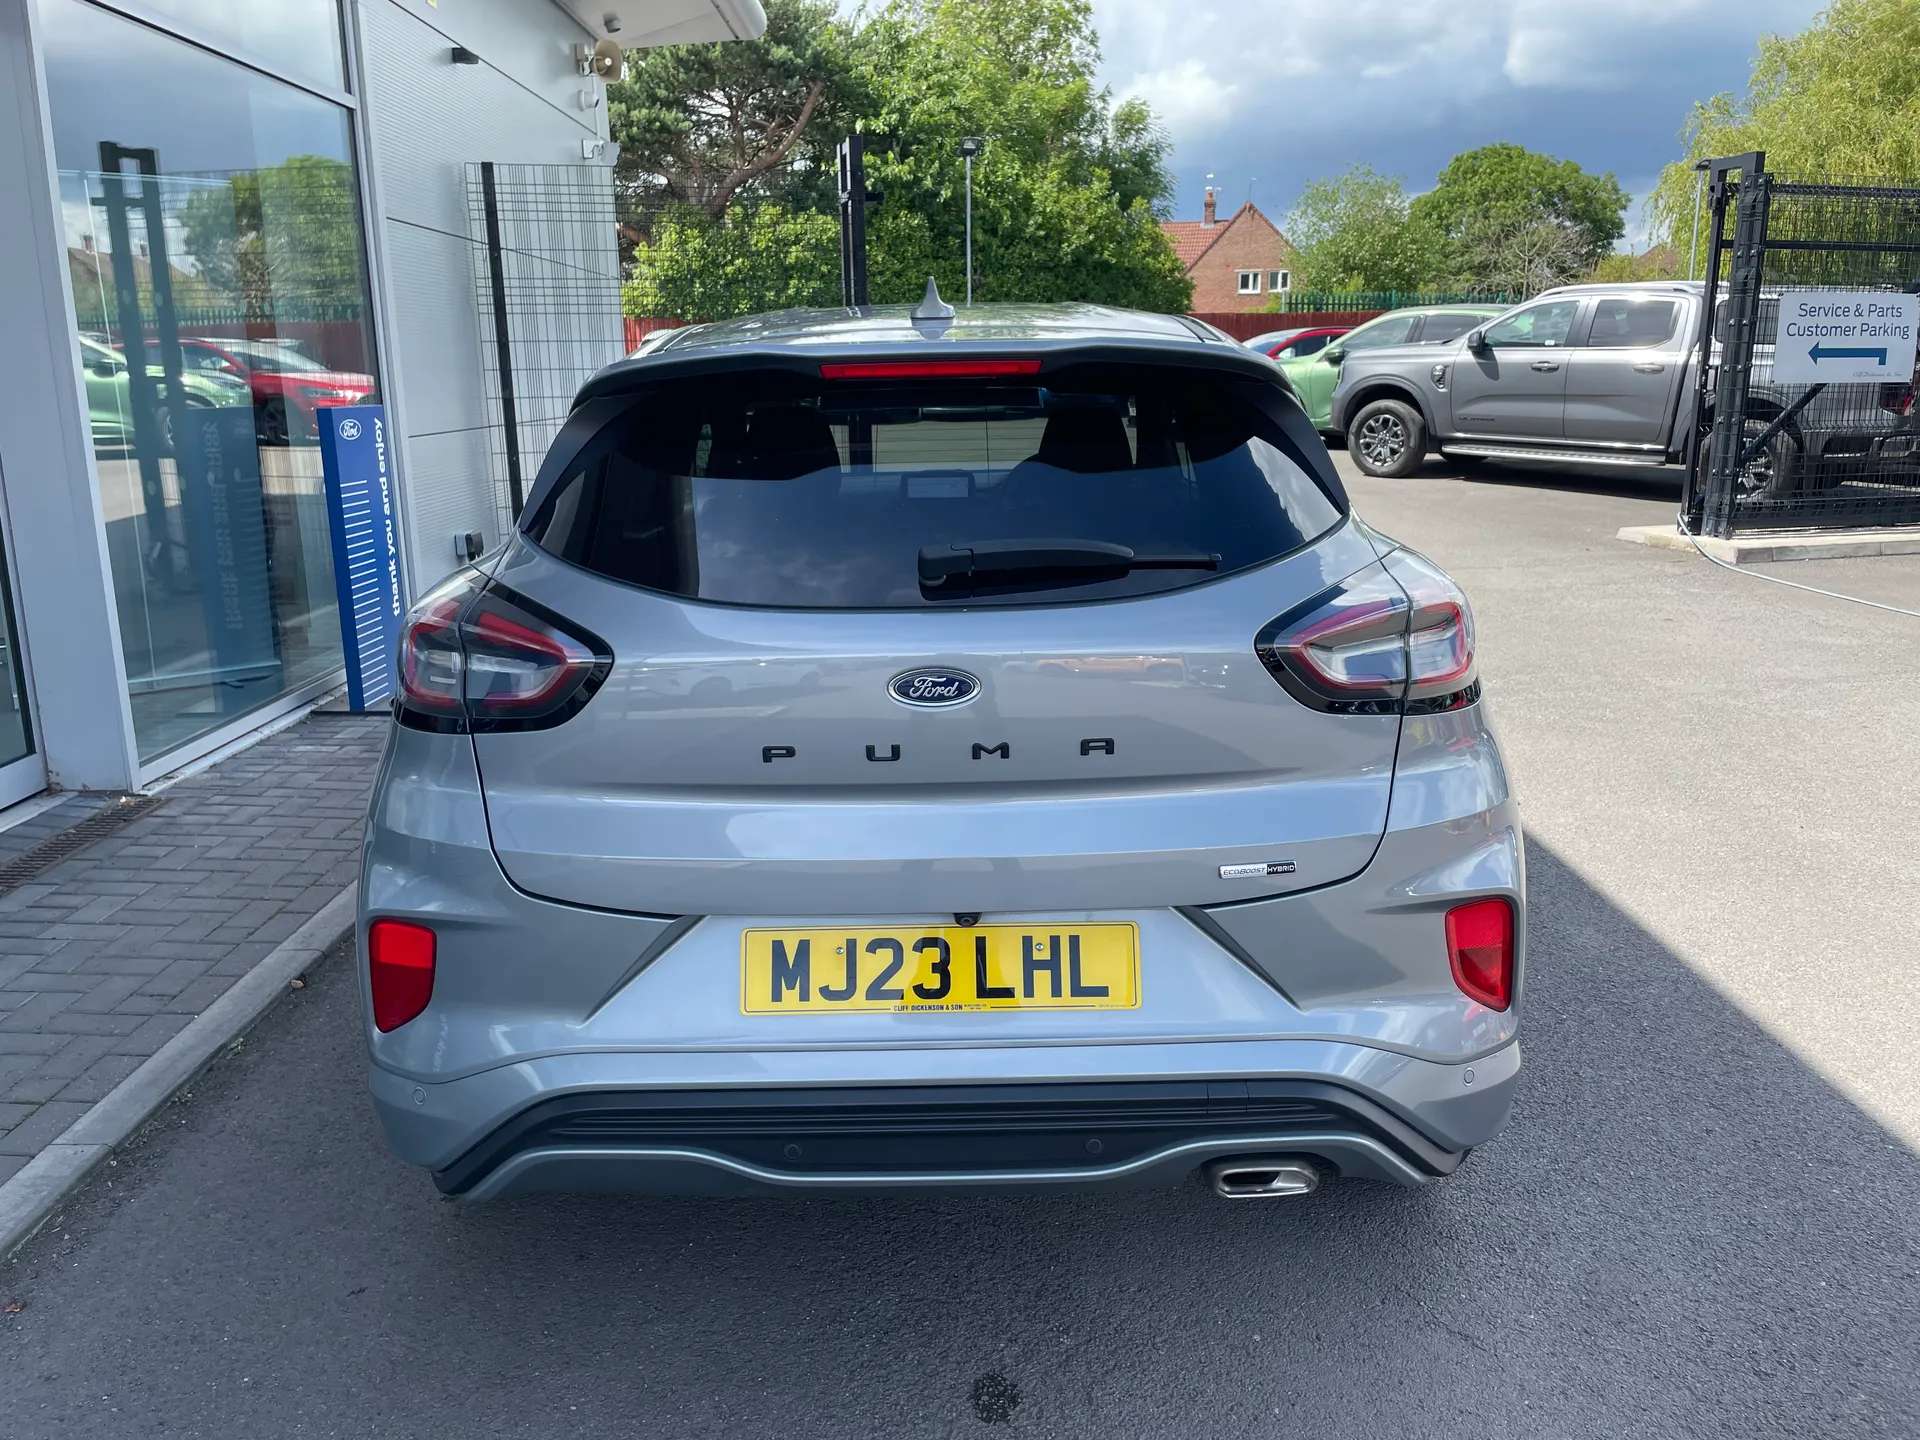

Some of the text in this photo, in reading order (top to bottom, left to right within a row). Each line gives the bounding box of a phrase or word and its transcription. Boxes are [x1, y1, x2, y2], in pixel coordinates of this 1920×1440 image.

[1798, 303, 1902, 318] Service & Parts
[1786, 322, 1910, 340] Customer Parking
[374, 417, 401, 617] thank you and enjoy
[909, 676, 958, 699] Ford
[762, 737, 1115, 764] PUMA
[1267, 864, 1295, 873] HYBRID
[771, 934, 1110, 1003] MJ23 LHL
